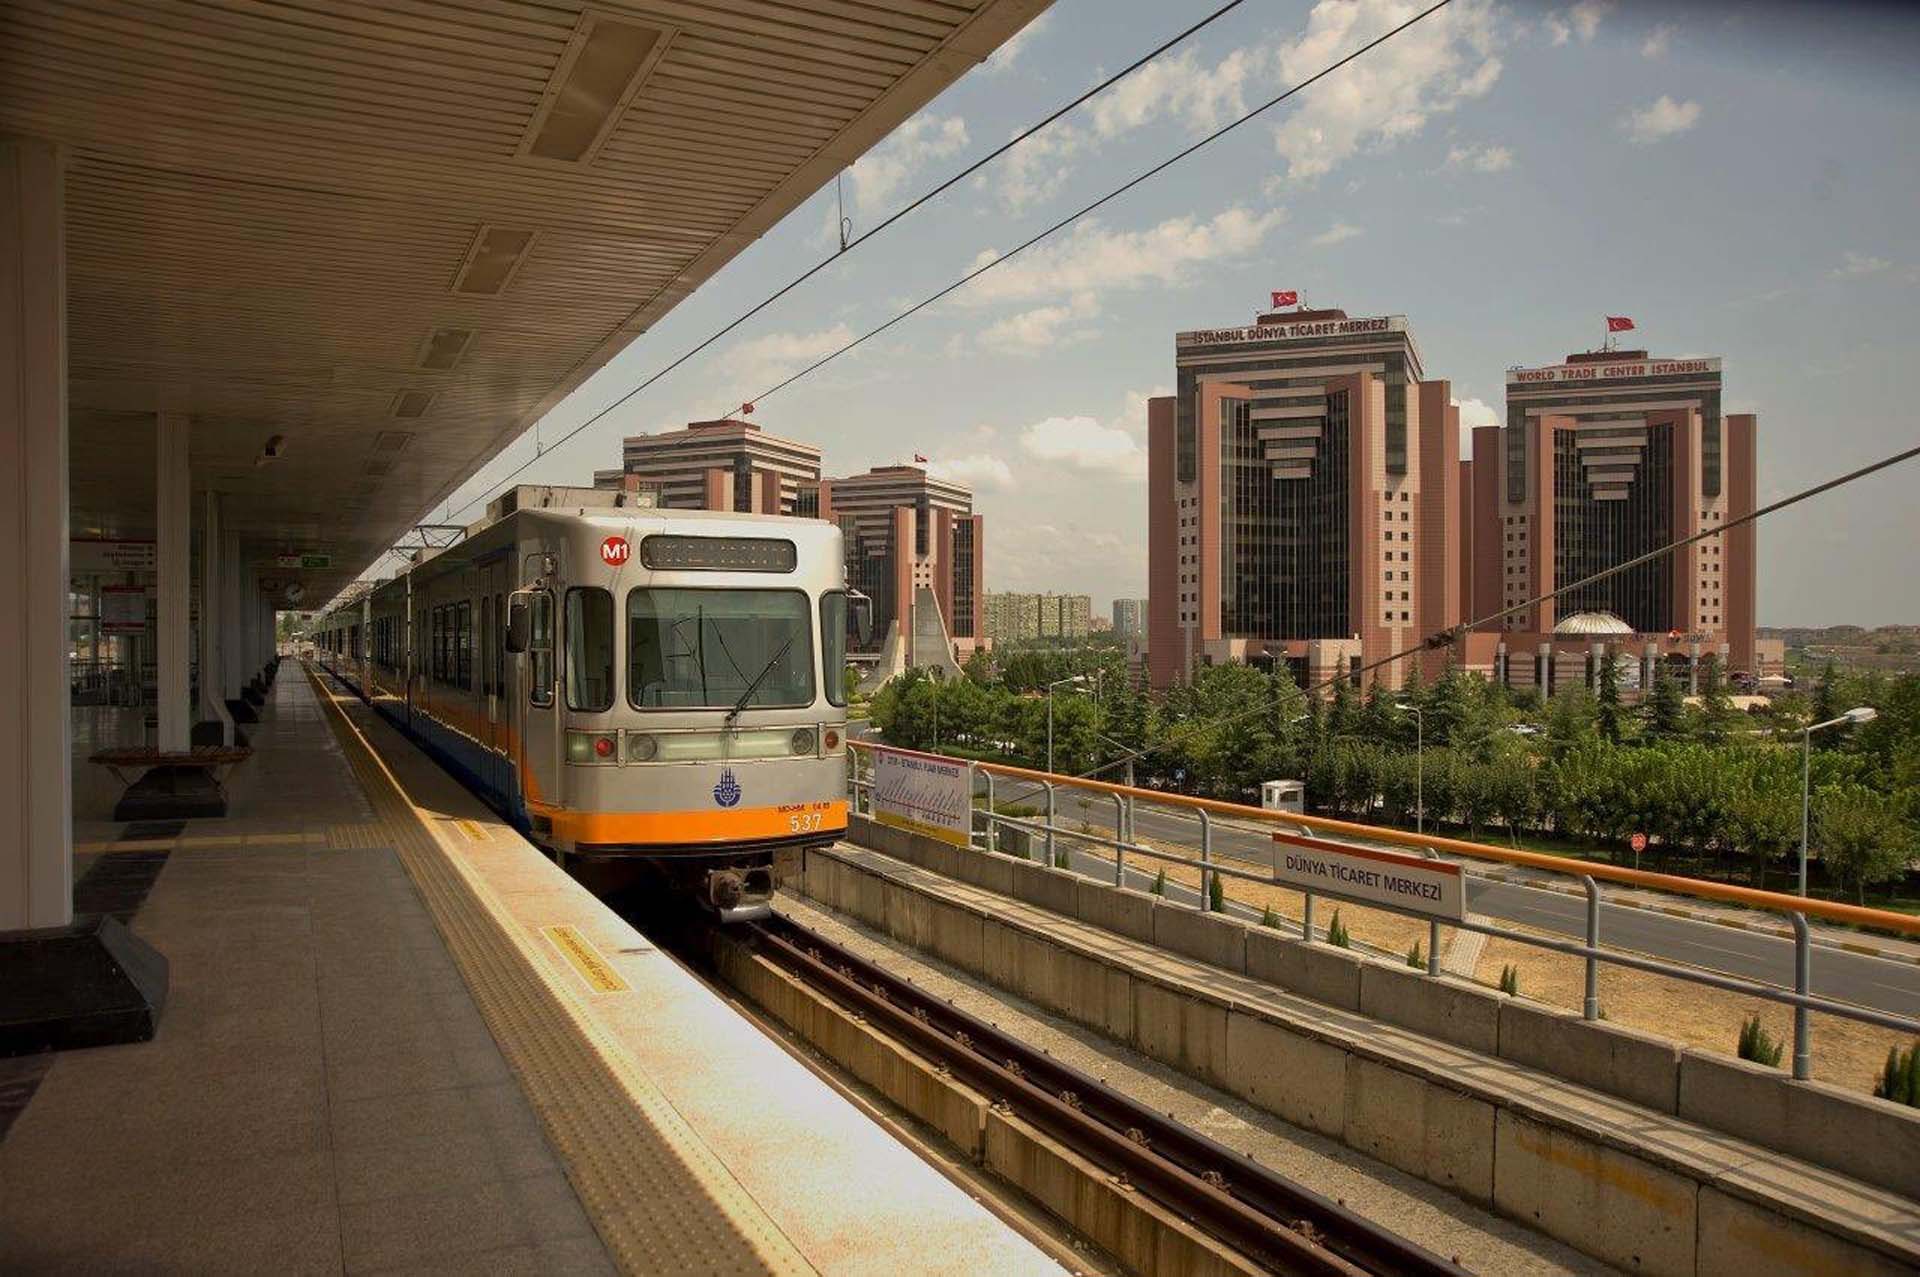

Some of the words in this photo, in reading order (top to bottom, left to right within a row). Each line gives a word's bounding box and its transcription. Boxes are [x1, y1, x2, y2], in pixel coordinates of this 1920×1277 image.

[1248, 326, 1286, 340] DÜNYA
[1290, 322, 1335, 336] TİCARET
[1339, 316, 1388, 333] MERKEZİ
[1516, 371, 1555, 382] WORLD
[1561, 368, 1597, 379] TRADE
[1603, 365, 1645, 377] CENTER
[603, 543, 628, 559] M1
[791, 814, 821, 832] 537
[1286, 855, 1327, 878] DÜNYA
[1330, 862, 1381, 888] TİCARET
[1384, 875, 1442, 901] MERKEZİ
